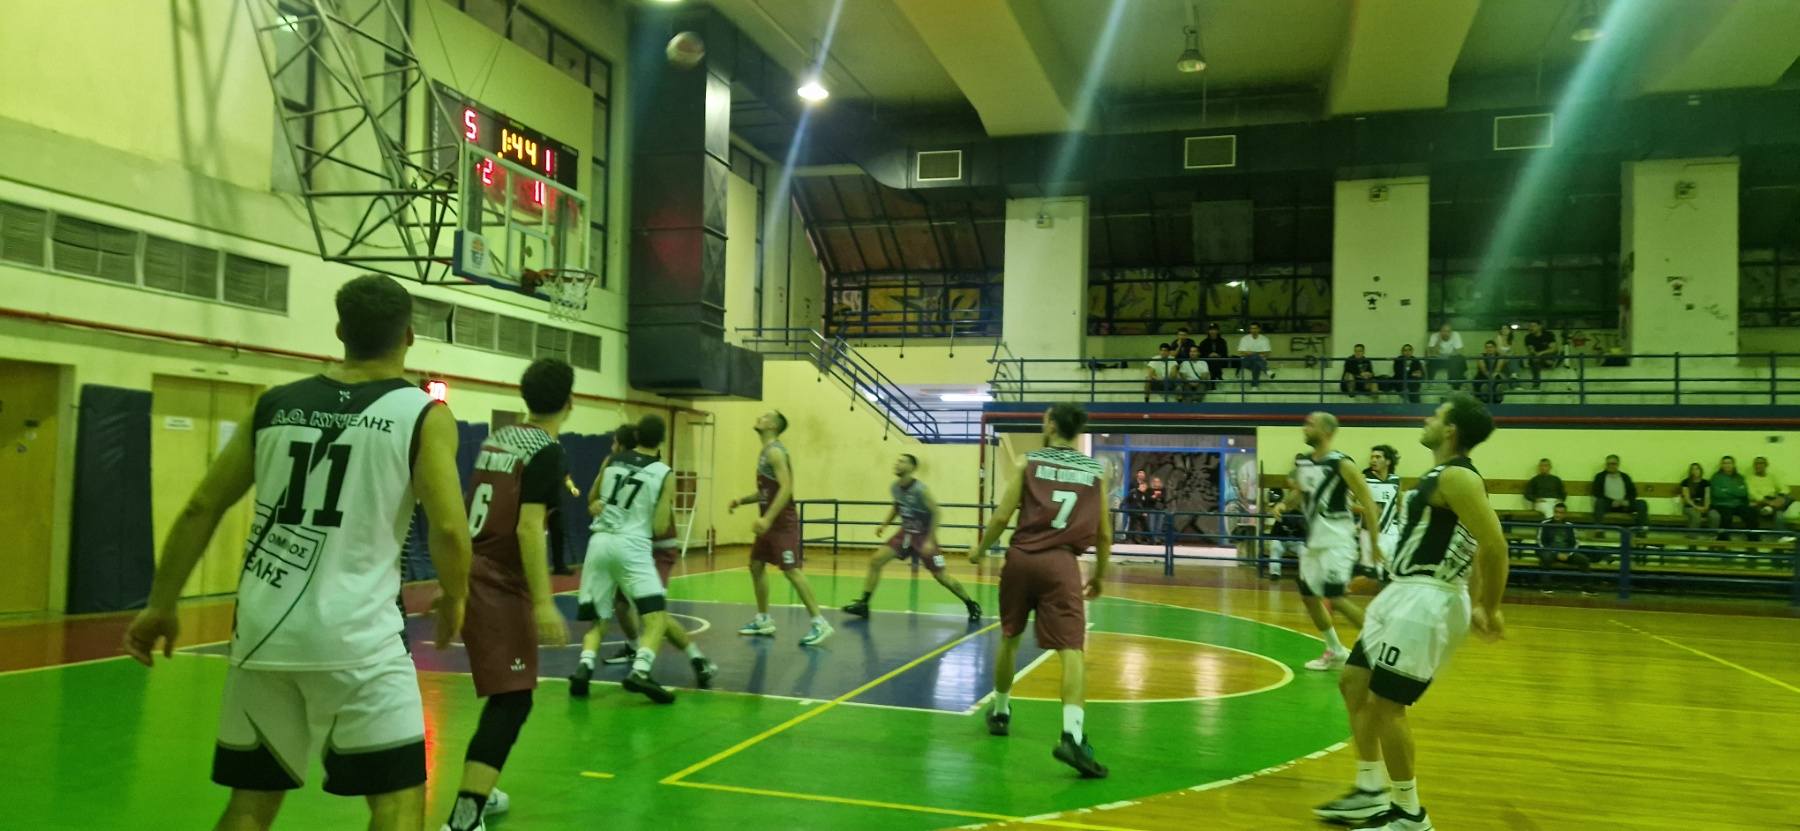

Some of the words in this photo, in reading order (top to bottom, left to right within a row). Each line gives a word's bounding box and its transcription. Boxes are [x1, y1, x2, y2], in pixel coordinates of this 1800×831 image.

[501, 127, 538, 167] 1:44
[309, 410, 395, 434] ΚΥΨΕΛΗΣ
[276, 441, 353, 528] 11
[606, 473, 644, 510] 17
[469, 482, 493, 538] 6
[1050, 489, 1078, 530] 7
[1377, 642, 1401, 667] 10
